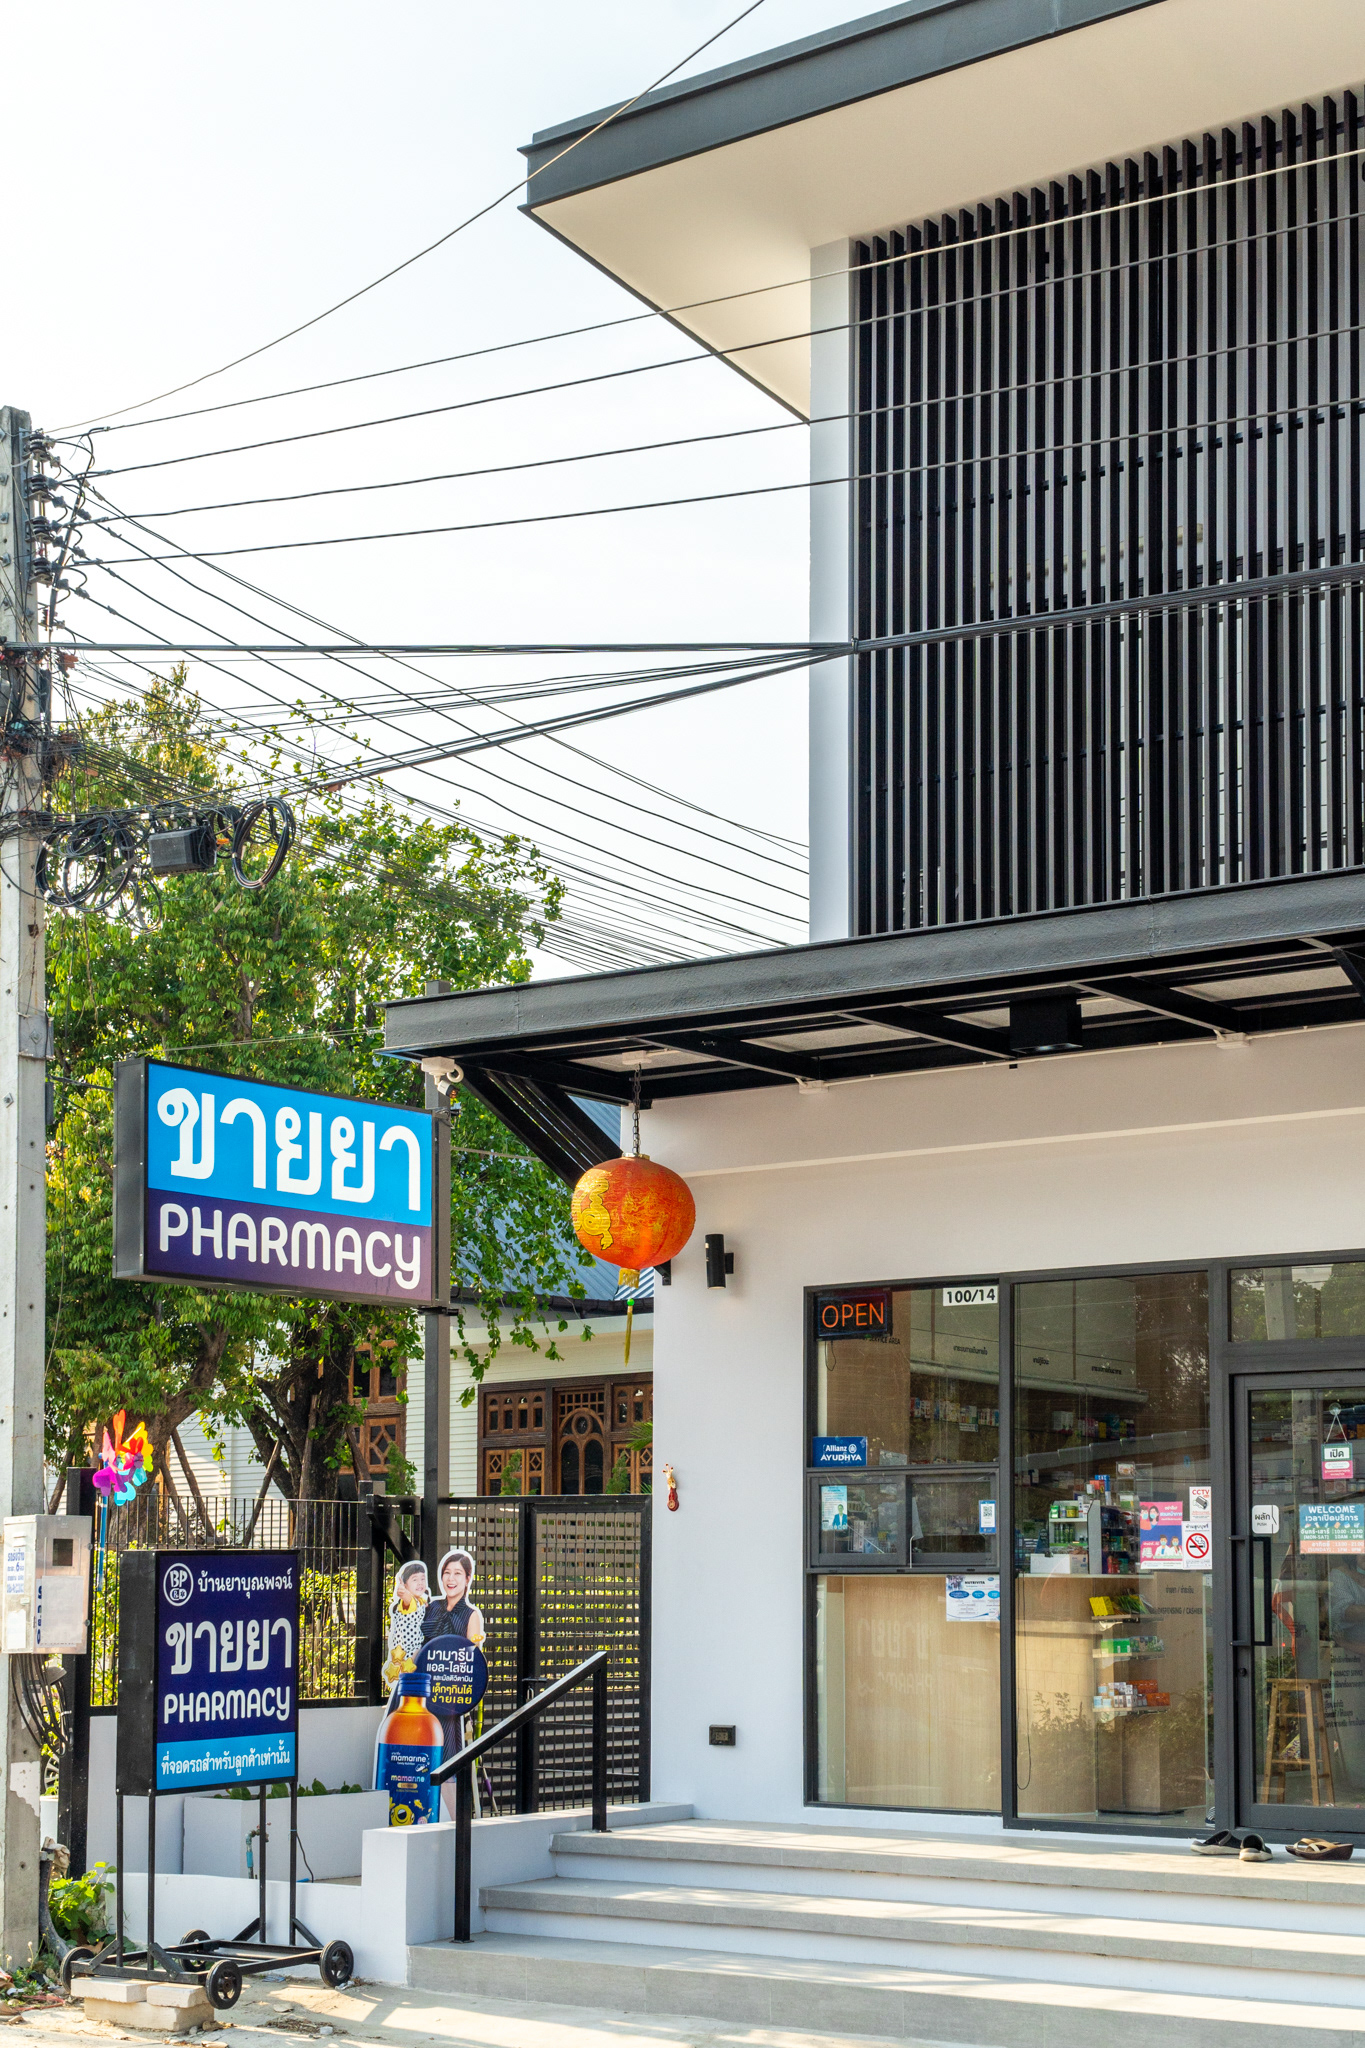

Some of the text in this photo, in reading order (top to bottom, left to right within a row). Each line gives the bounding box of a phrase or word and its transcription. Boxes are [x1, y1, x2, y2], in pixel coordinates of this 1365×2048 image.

[157, 1087, 421, 1211] ขายยา
[159, 1203, 421, 1290] PHARMACY
[947, 1288, 996, 1304] 100/14
[822, 1302, 884, 1328] OPEN
[1330, 1449, 1344, 1458] เปิด
[170, 1570, 188, 1587] BP
[198, 1567, 292, 1599] บ้านยาบุณพจน์
[165, 1617, 292, 1675] ขายยา
[428, 1647, 474, 1662] มามารีน
[427, 1661, 473, 1673] แอล-ไลซีน
[164, 1686, 290, 1724] PHARMACY
[432, 1693, 472, 1704] ง่ายเลย
[161, 1739, 290, 1776] ที่จอดรถสำหรับลูกค้าเท่านั้น
